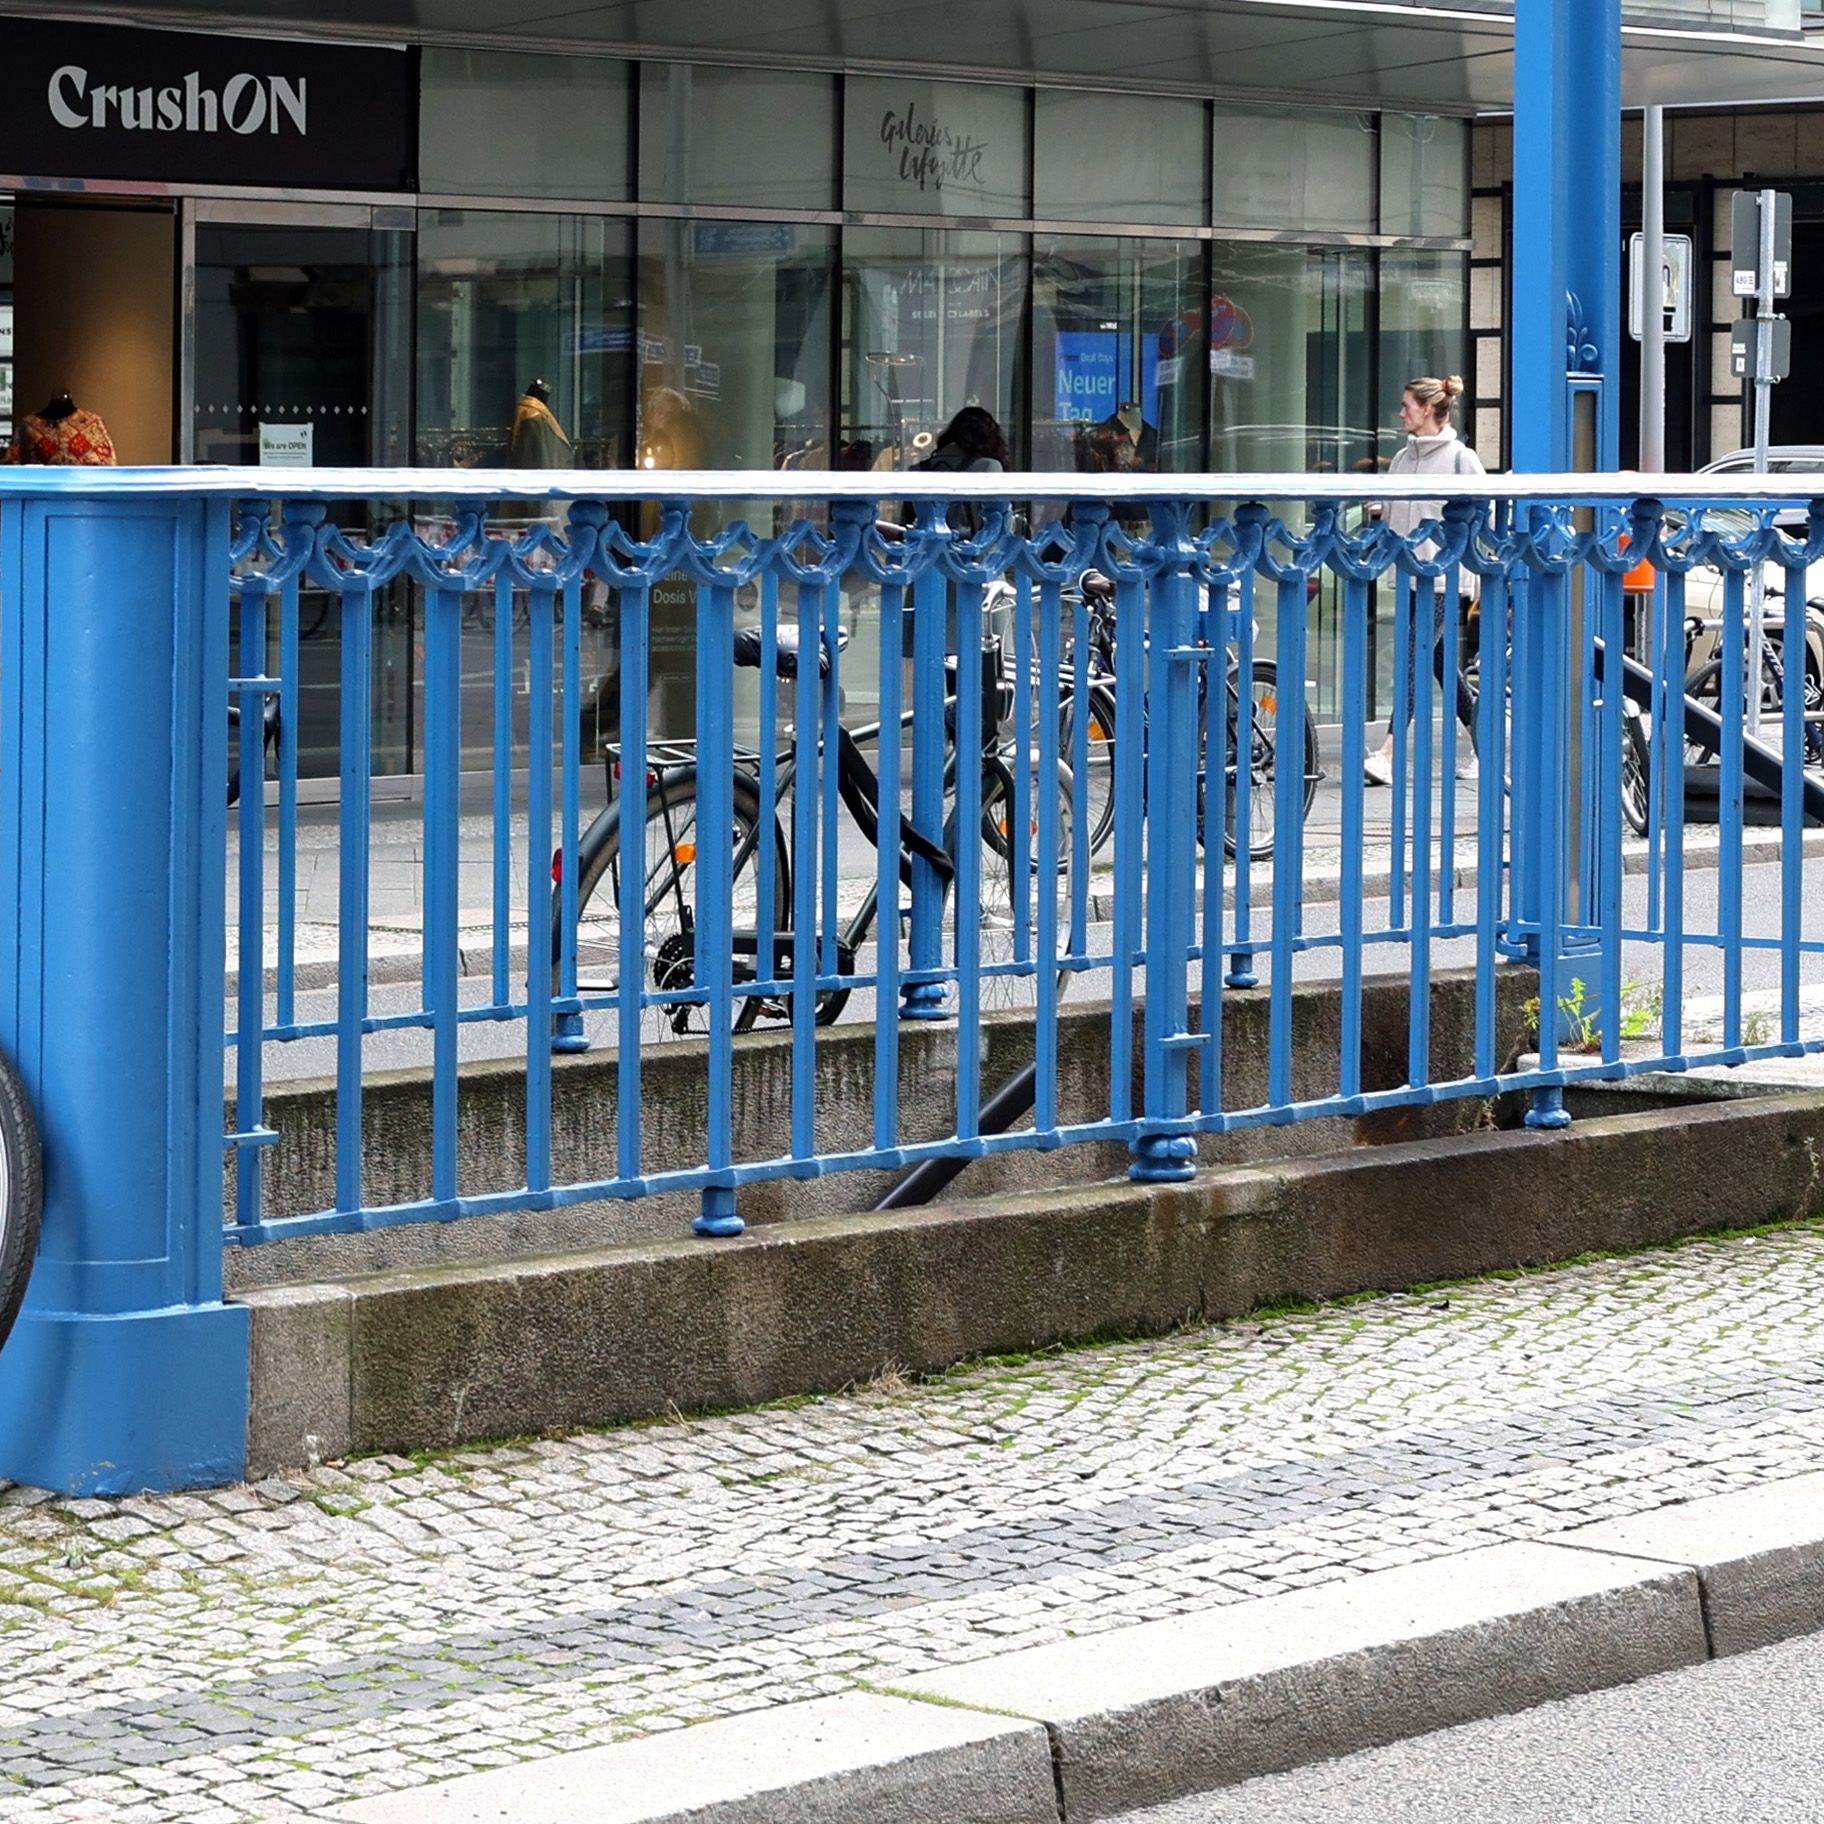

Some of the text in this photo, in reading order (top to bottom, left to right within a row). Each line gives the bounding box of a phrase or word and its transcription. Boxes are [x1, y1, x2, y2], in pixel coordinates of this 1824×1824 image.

[48, 65, 306, 136] CrushON
[1058, 370, 1115, 395] Neuer
[653, 589, 686, 604] Dosis
